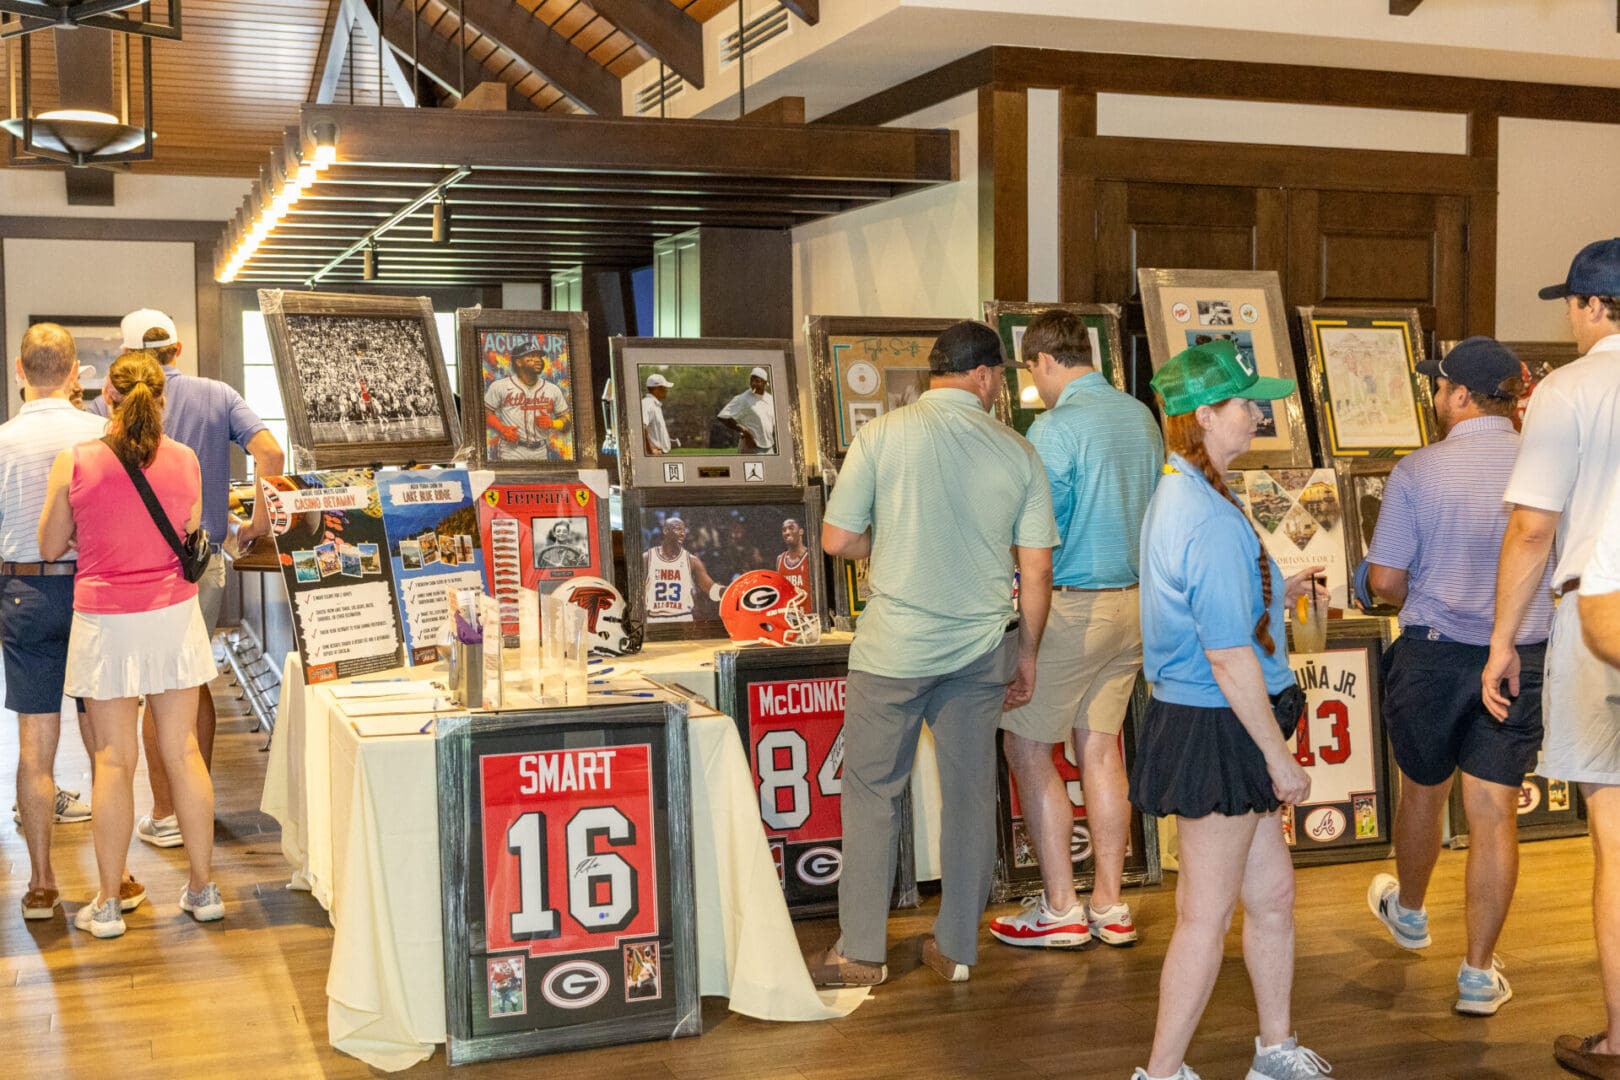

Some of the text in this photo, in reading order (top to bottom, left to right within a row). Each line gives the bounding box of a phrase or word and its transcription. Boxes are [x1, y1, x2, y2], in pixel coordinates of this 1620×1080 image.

[294, 494, 356, 511] CASINO GETAWAY
[402, 489, 452, 503] LAKE BLUE RIDGE
[506, 490, 571, 505] Ferrari
[1278, 555, 1310, 565] ORTONA
[660, 568, 682, 581] NBA
[654, 582, 682, 602] 23
[1294, 660, 1356, 699] UÑA JR.
[758, 680, 847, 717] McCONKE
[518, 750, 617, 795] SMART
[506, 804, 640, 941] 16
